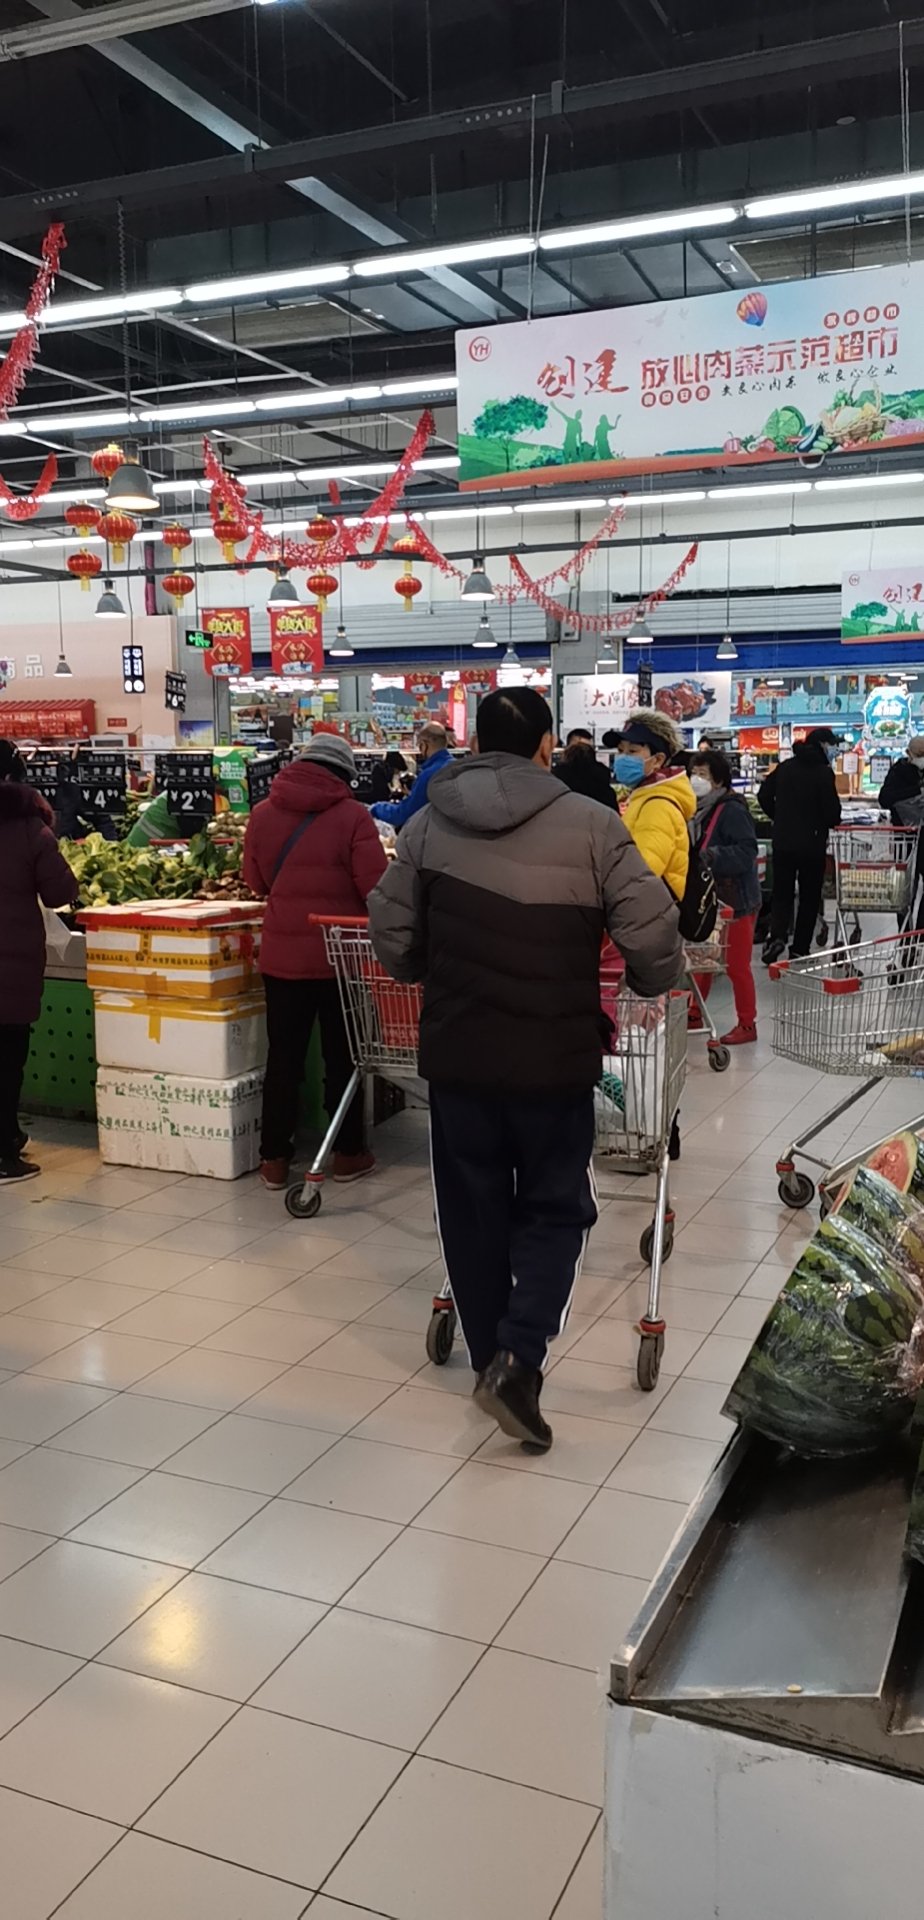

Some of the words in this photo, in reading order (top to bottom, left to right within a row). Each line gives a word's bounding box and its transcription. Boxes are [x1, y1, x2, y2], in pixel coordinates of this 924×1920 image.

[641, 327, 899, 389] 放心肉菜示范超市
